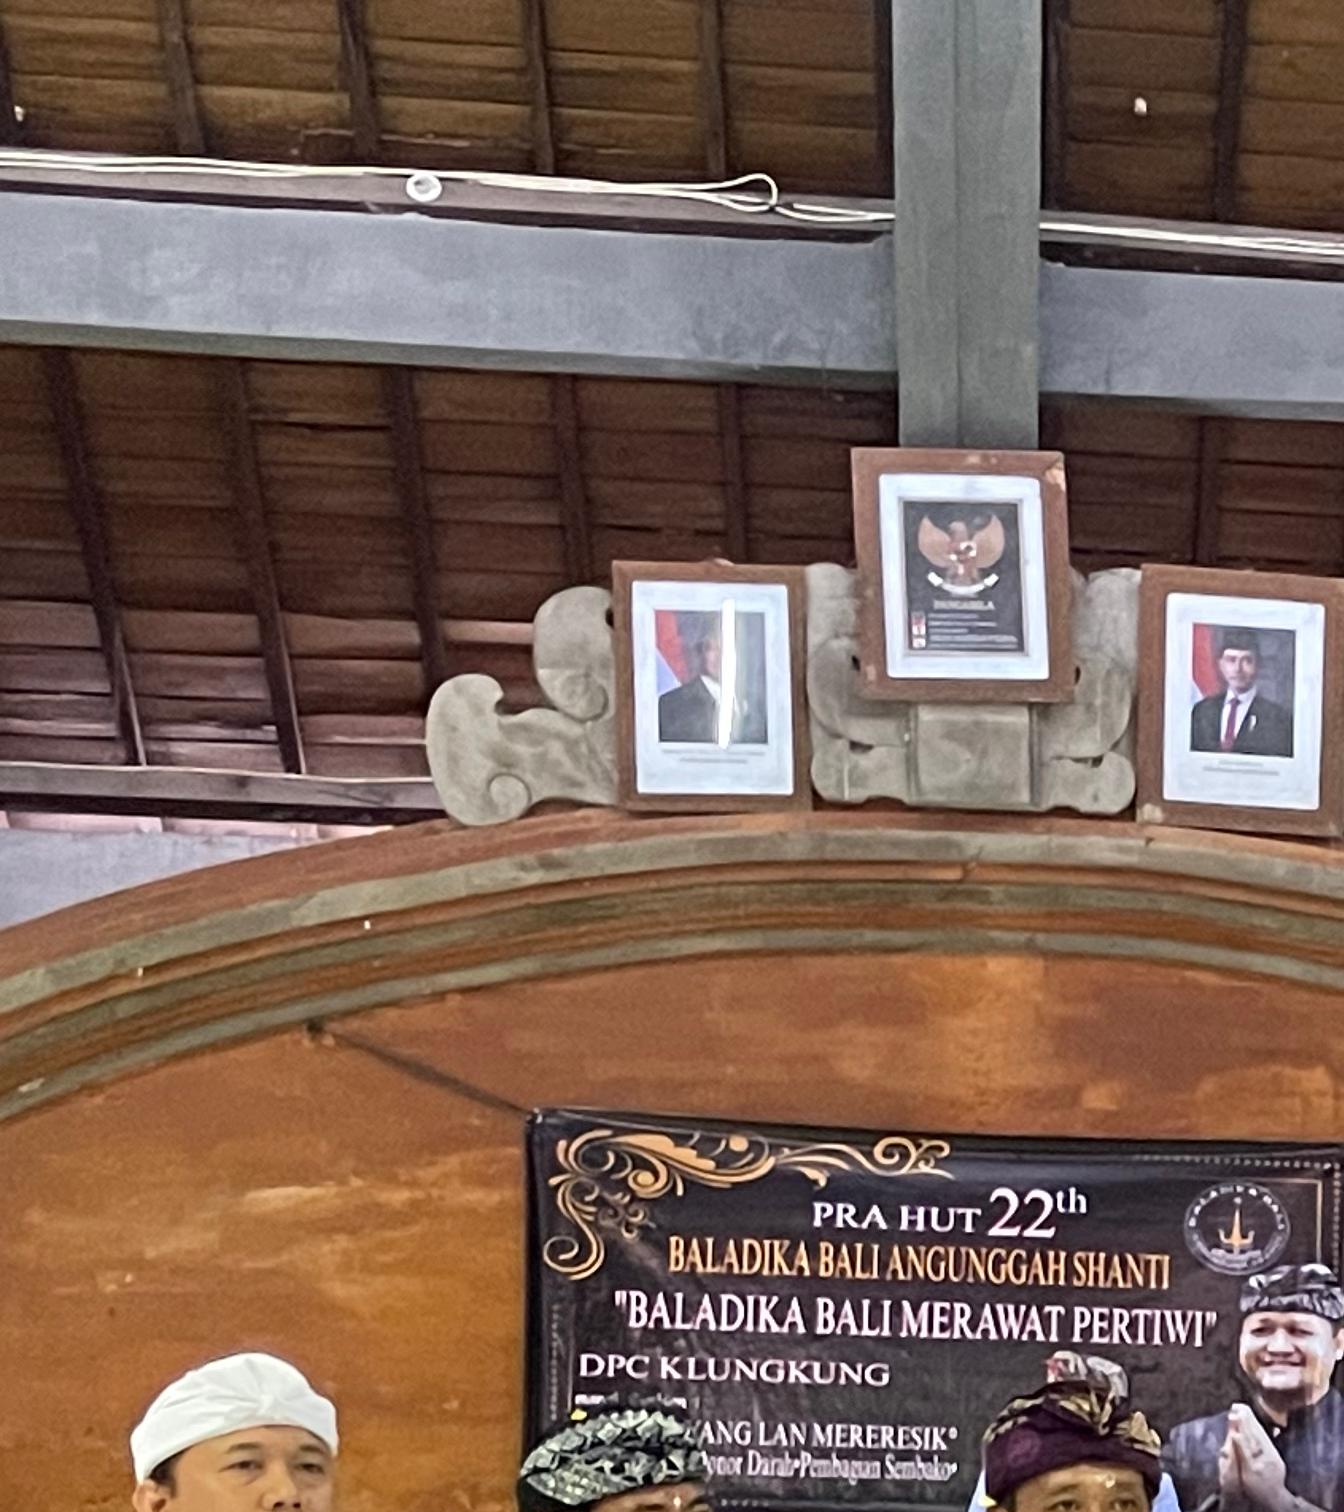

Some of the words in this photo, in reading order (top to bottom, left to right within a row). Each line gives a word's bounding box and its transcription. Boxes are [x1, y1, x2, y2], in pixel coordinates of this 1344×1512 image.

[812, 1201, 888, 1230] PRA
[899, 1205, 982, 1233] HUT
[987, 1186, 1088, 1238] 22th
[668, 1234, 811, 1277] BALADIKA
[818, 1240, 880, 1281] BALI
[886, 1244, 1067, 1287] ANGUNGGAH
[1072, 1250, 1171, 1290] SHANTI
[614, 1288, 808, 1334] "BALADIKA
[814, 1296, 892, 1338] BALI
[898, 1300, 1066, 1342] MERAWAT
[578, 1352, 650, 1379] DPC
[660, 1355, 890, 1388] KLUNGKUNG
[758, 1420, 807, 1448] LAN
